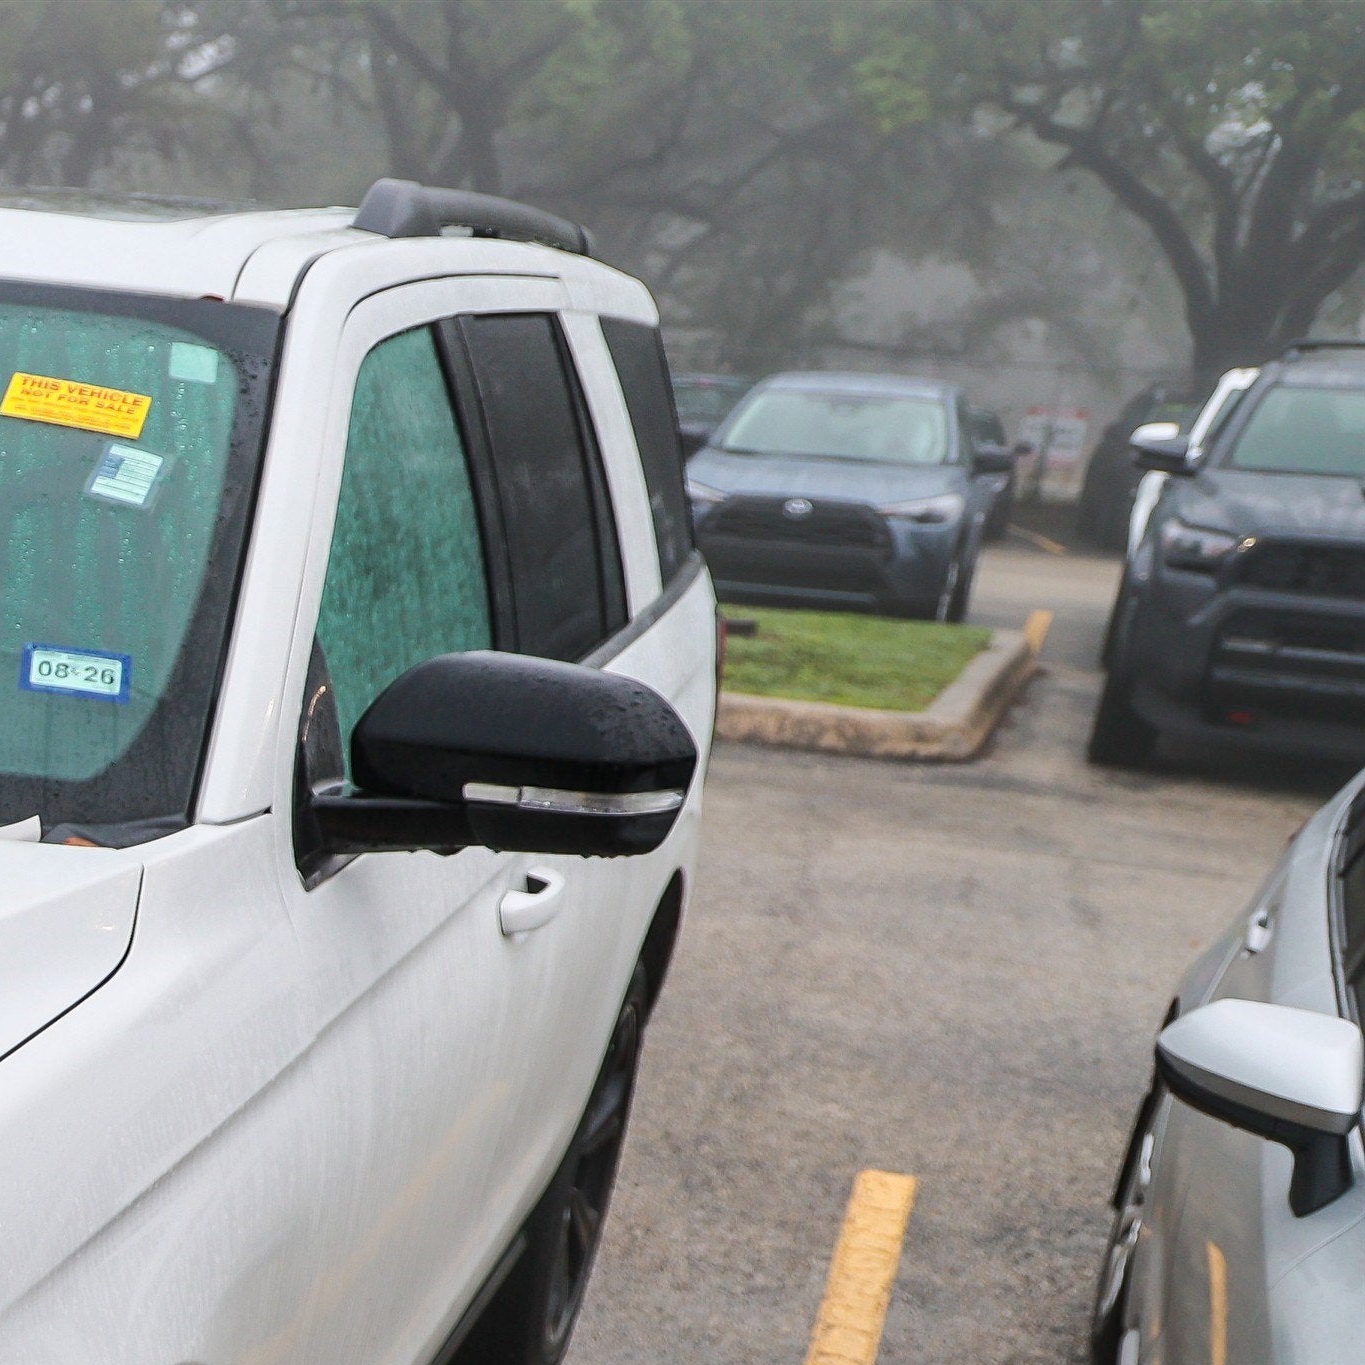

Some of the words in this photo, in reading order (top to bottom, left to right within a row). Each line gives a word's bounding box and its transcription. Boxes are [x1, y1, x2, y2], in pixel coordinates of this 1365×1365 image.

[21, 376, 61, 391] THIS
[67, 386, 144, 407] VEHICLE
[21, 389, 52, 398] NOT
[58, 394, 89, 405] FOR
[96, 402, 135, 415] SALE
